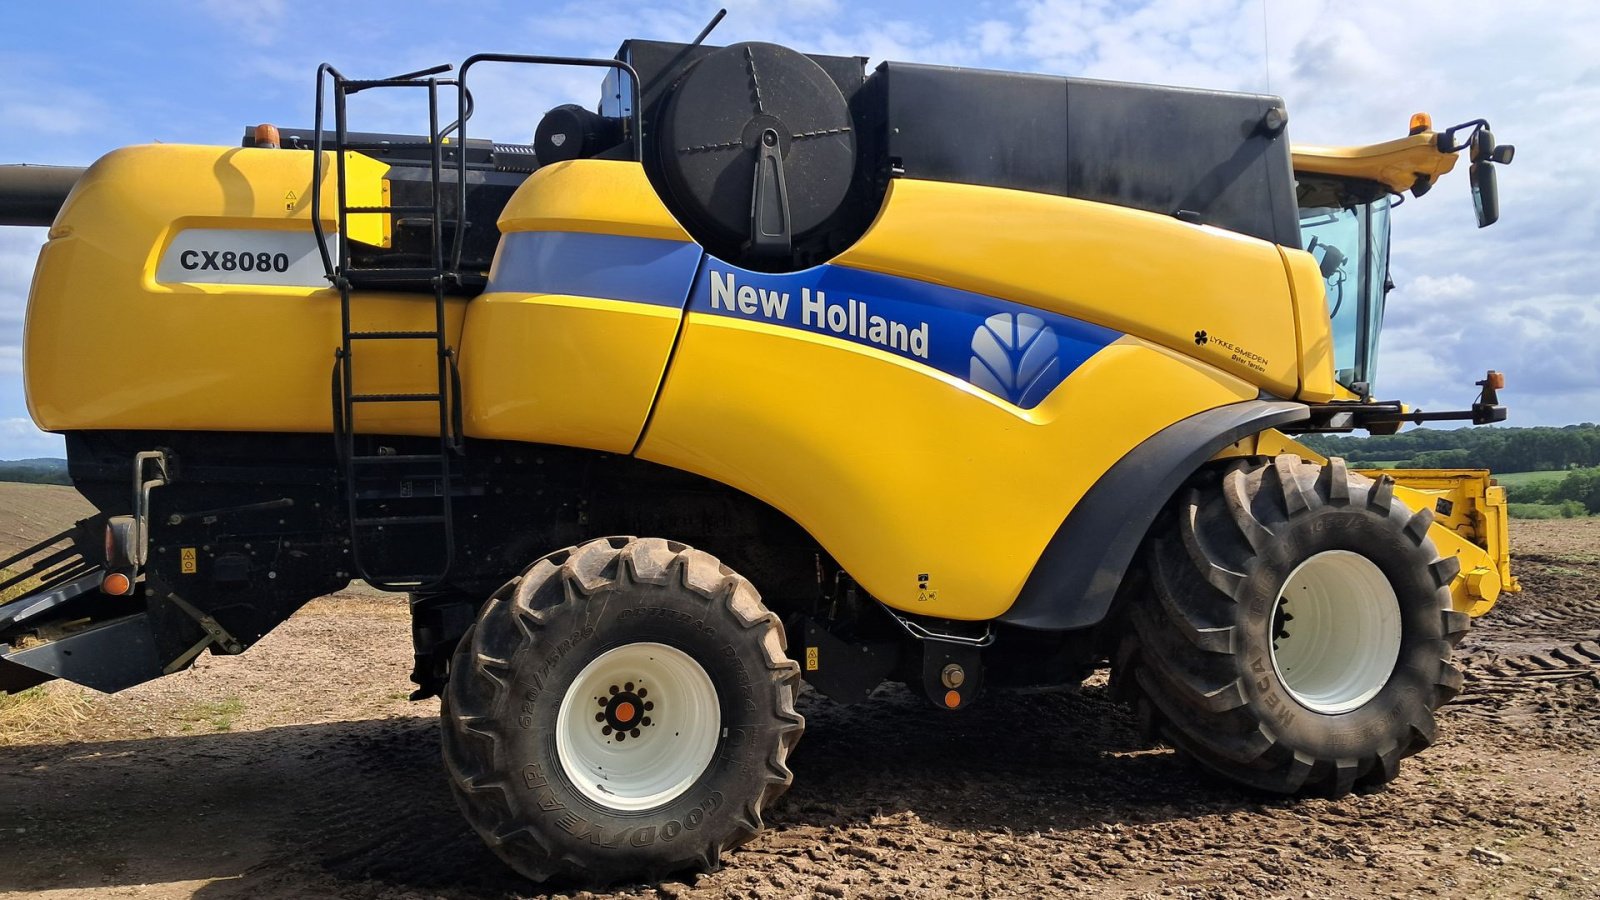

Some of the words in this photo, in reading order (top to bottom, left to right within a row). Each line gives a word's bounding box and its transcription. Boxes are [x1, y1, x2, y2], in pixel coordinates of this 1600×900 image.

[180, 249, 289, 273] CX8080
[709, 270, 789, 320] New
[801, 286, 929, 359] Holland
[1210, 335, 1233, 350] LYKKE
[1234, 346, 1268, 365] SMEDEN
[522, 762, 724, 849] GOODYEAR
